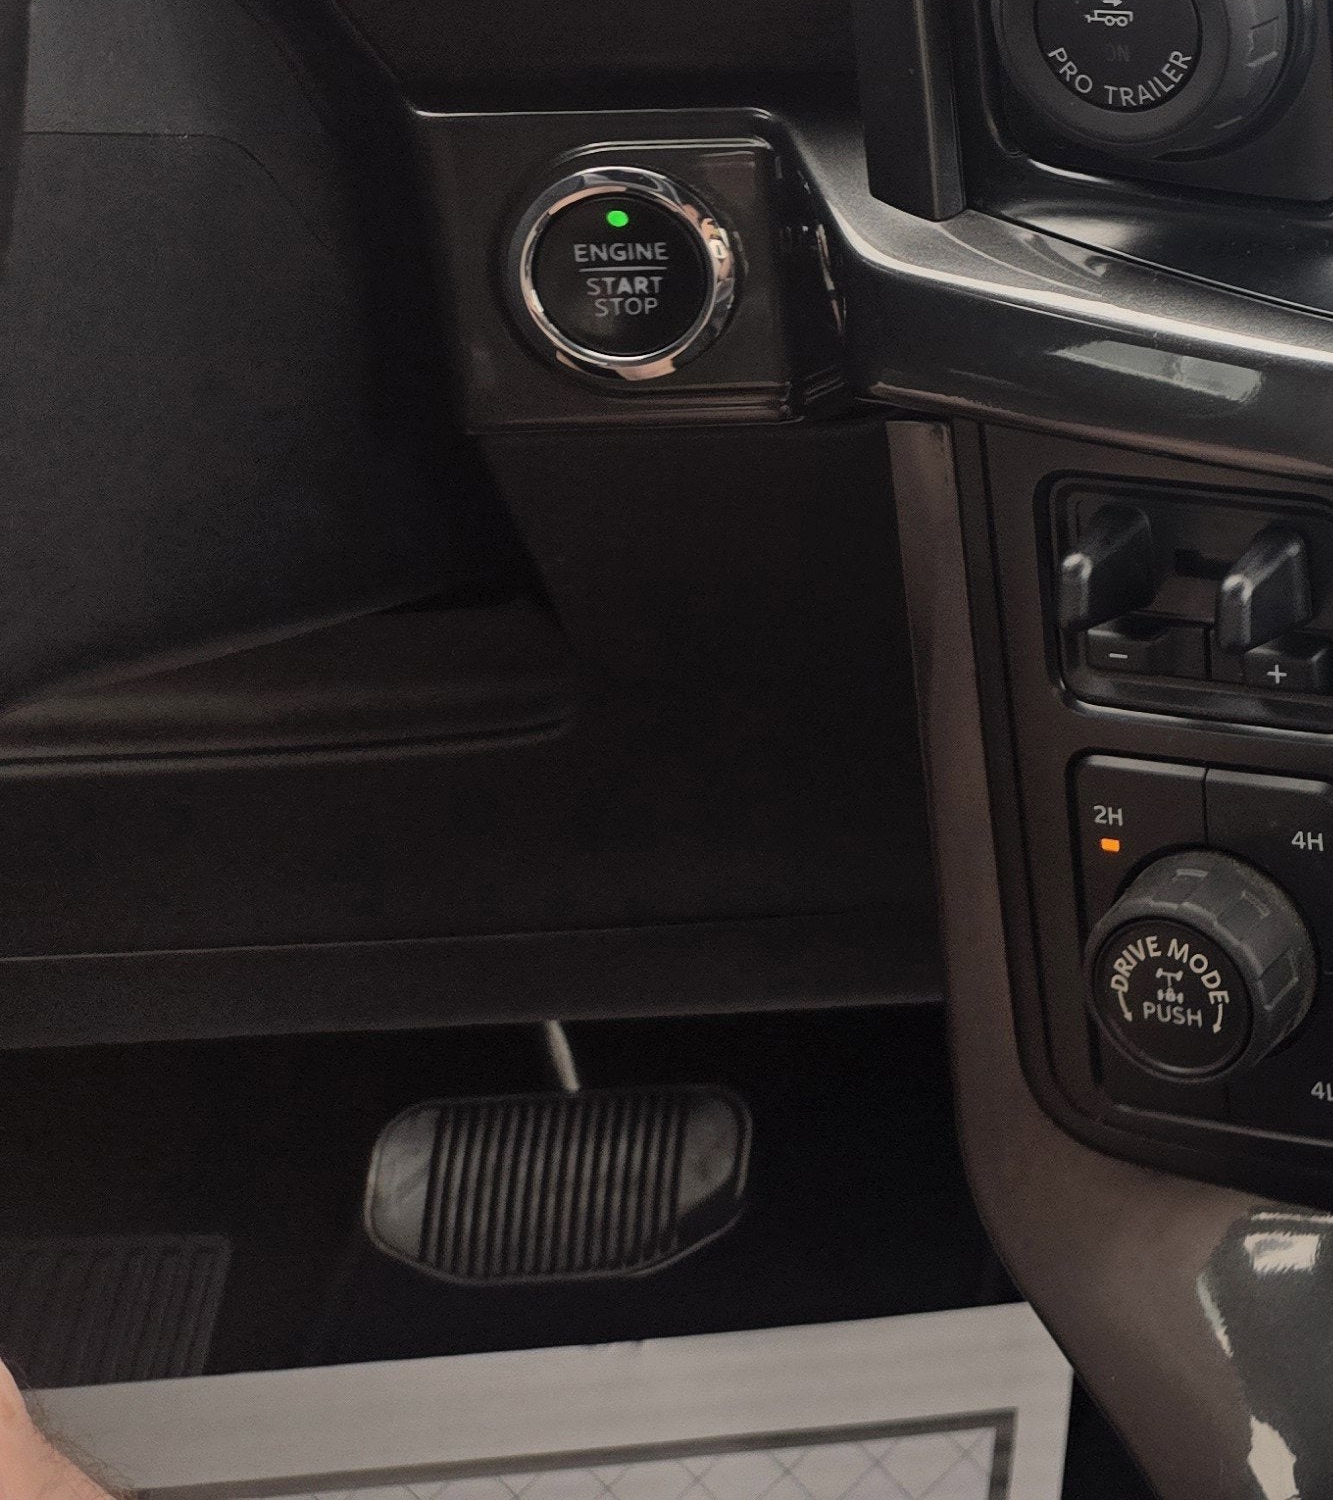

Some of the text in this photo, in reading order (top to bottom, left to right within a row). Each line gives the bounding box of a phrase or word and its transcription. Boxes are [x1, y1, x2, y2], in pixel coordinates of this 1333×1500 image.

[1048, 48, 1192, 108] PRO TRAILER
[573, 243, 668, 264] ENGINE
[586, 277, 661, 297] START
[593, 298, 658, 318] STOP
[1093, 806, 1123, 828] 2H
[1291, 831, 1324, 853] 4H
[1110, 936, 1230, 1005] DRIVE MODE
[1143, 1003, 1202, 1028] PUSH
